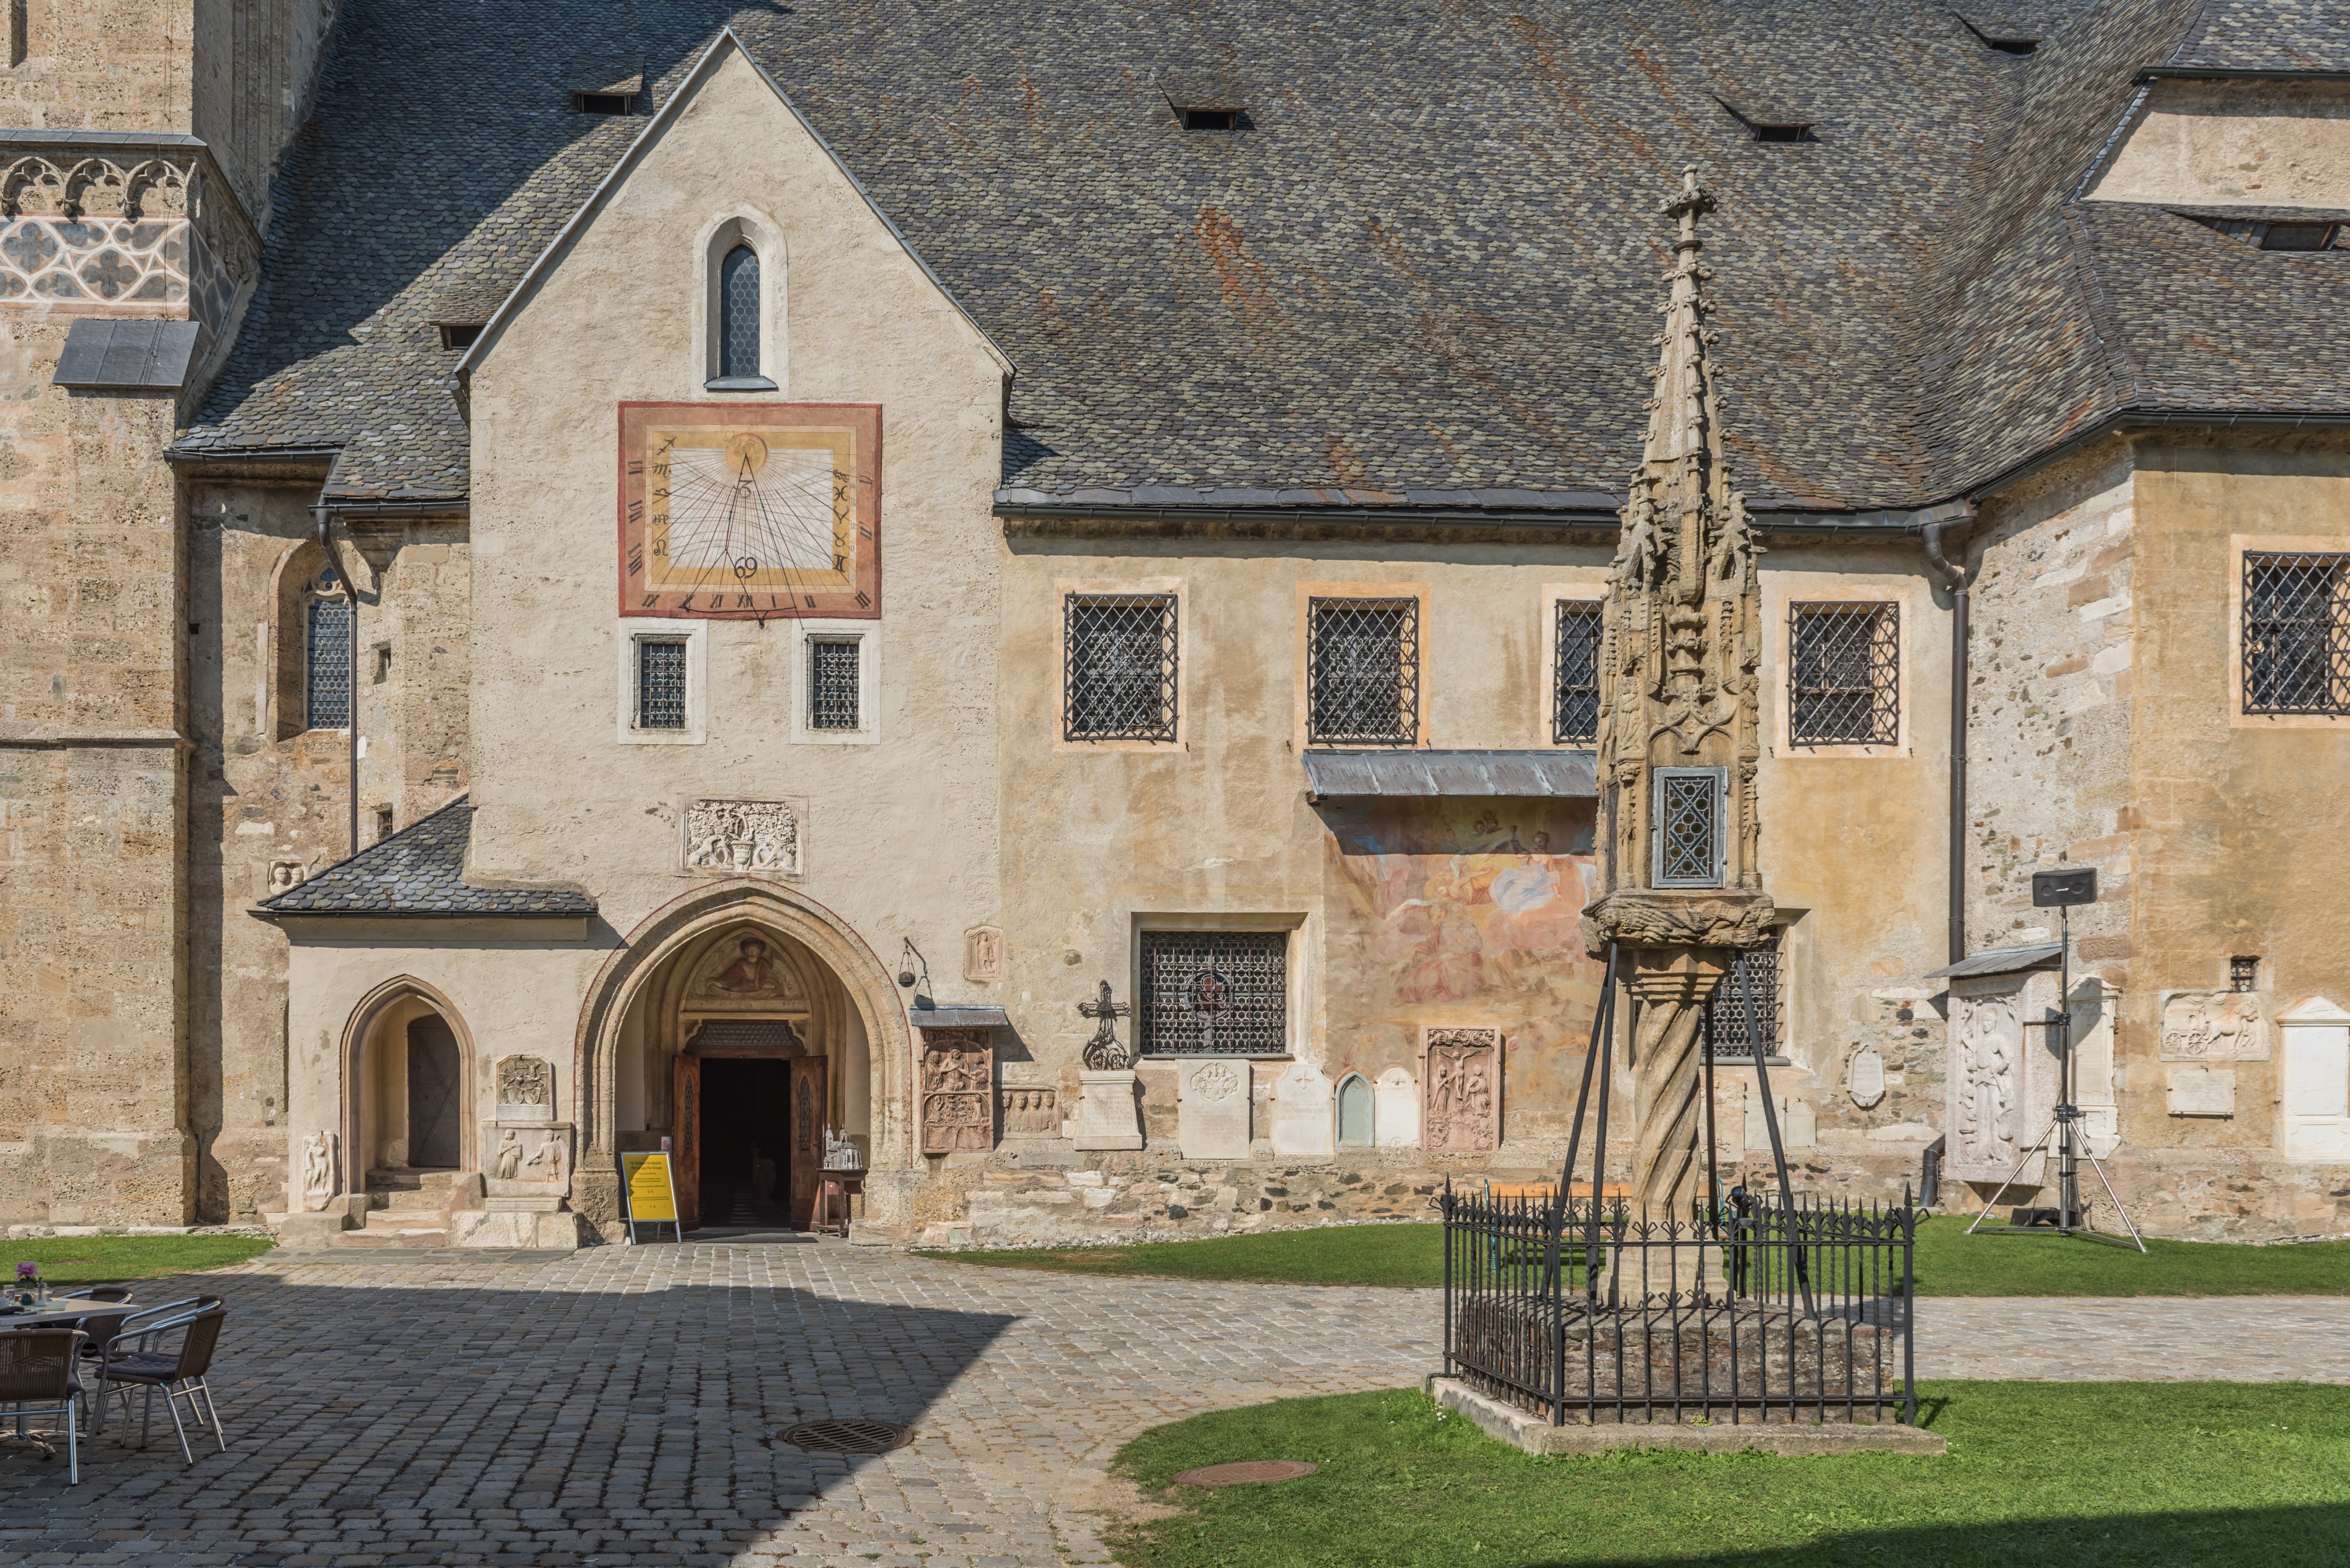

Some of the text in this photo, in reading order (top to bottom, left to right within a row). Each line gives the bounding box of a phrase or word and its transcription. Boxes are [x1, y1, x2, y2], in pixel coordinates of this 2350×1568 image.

[641, 593, 660, 608] IX
[710, 593, 724, 609] XI
[737, 594, 753, 609] XII
[771, 594, 777, 609] I
[804, 595, 817, 609] II
[854, 590, 872, 609] III
